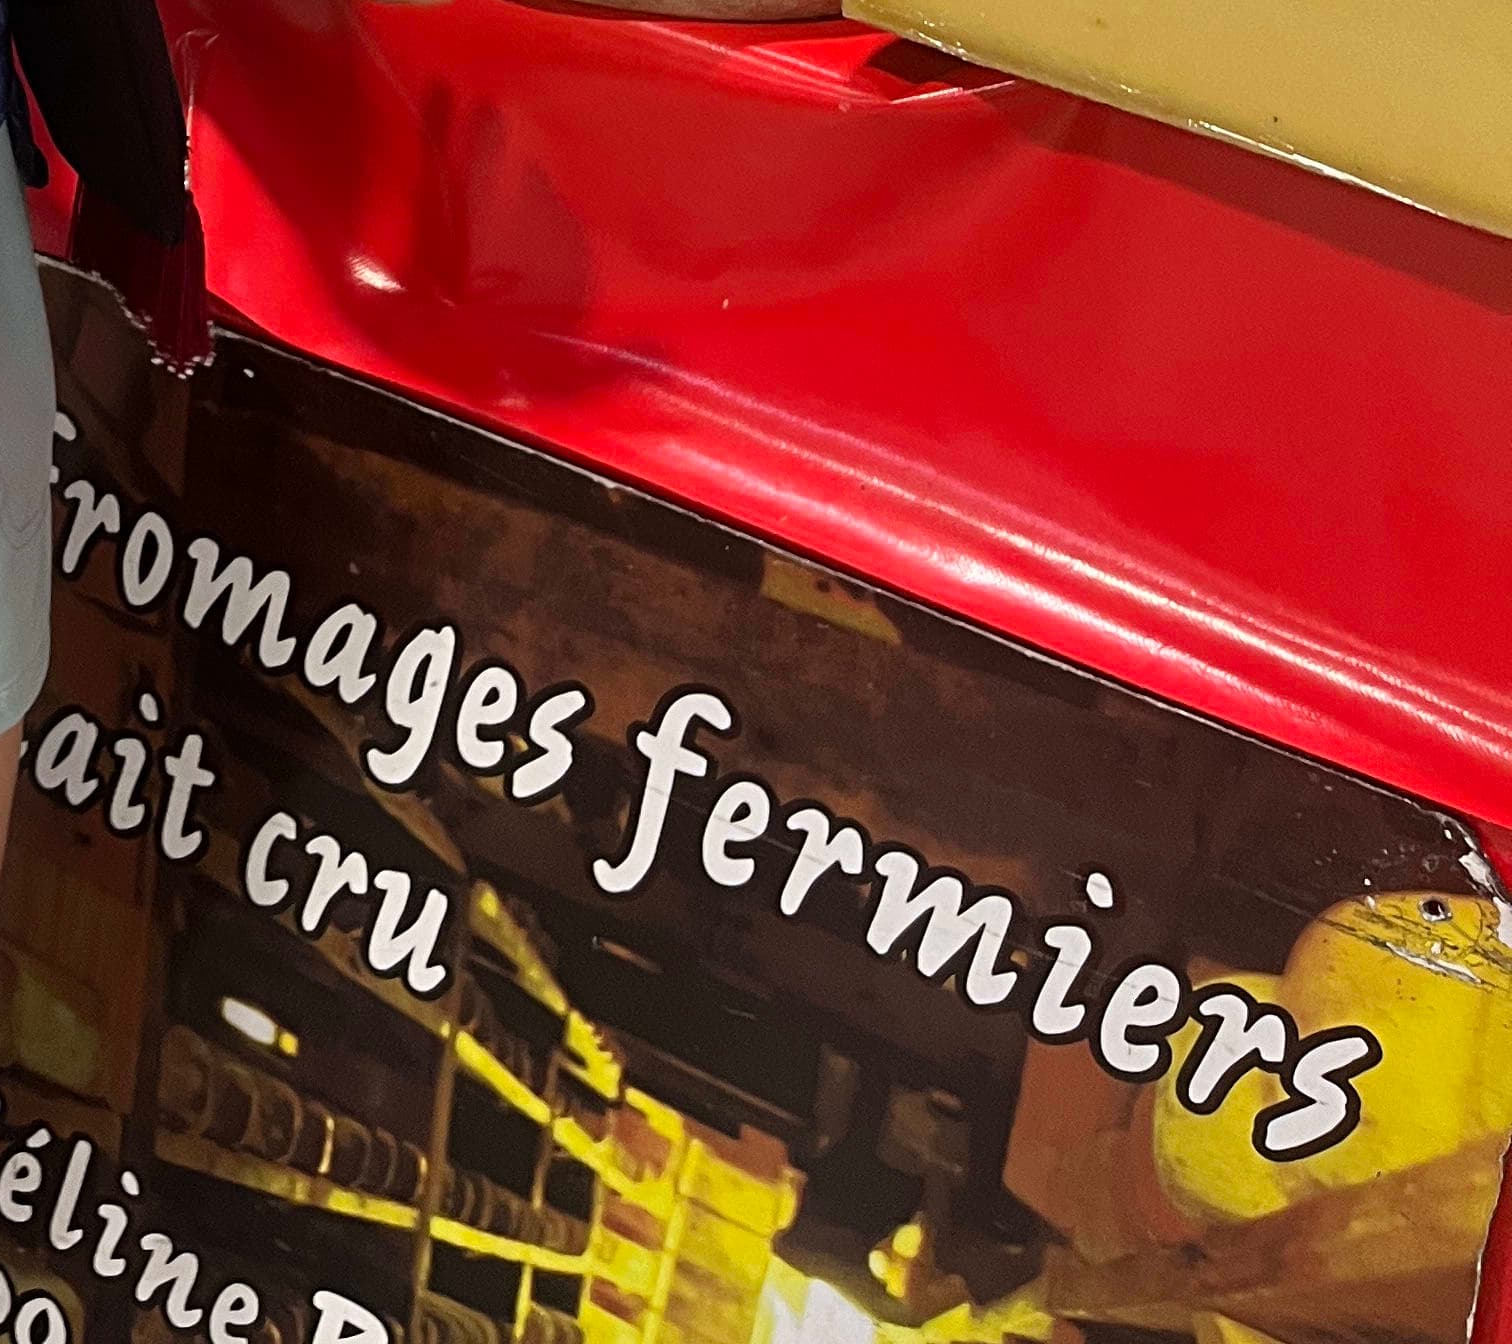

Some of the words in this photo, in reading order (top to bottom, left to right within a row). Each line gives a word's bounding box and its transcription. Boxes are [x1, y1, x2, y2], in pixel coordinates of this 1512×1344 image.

[19, 693, 216, 860] ait
[245, 812, 449, 993] cru
[52, 412, 587, 804] romages
[593, 693, 1370, 1152] fermiers
